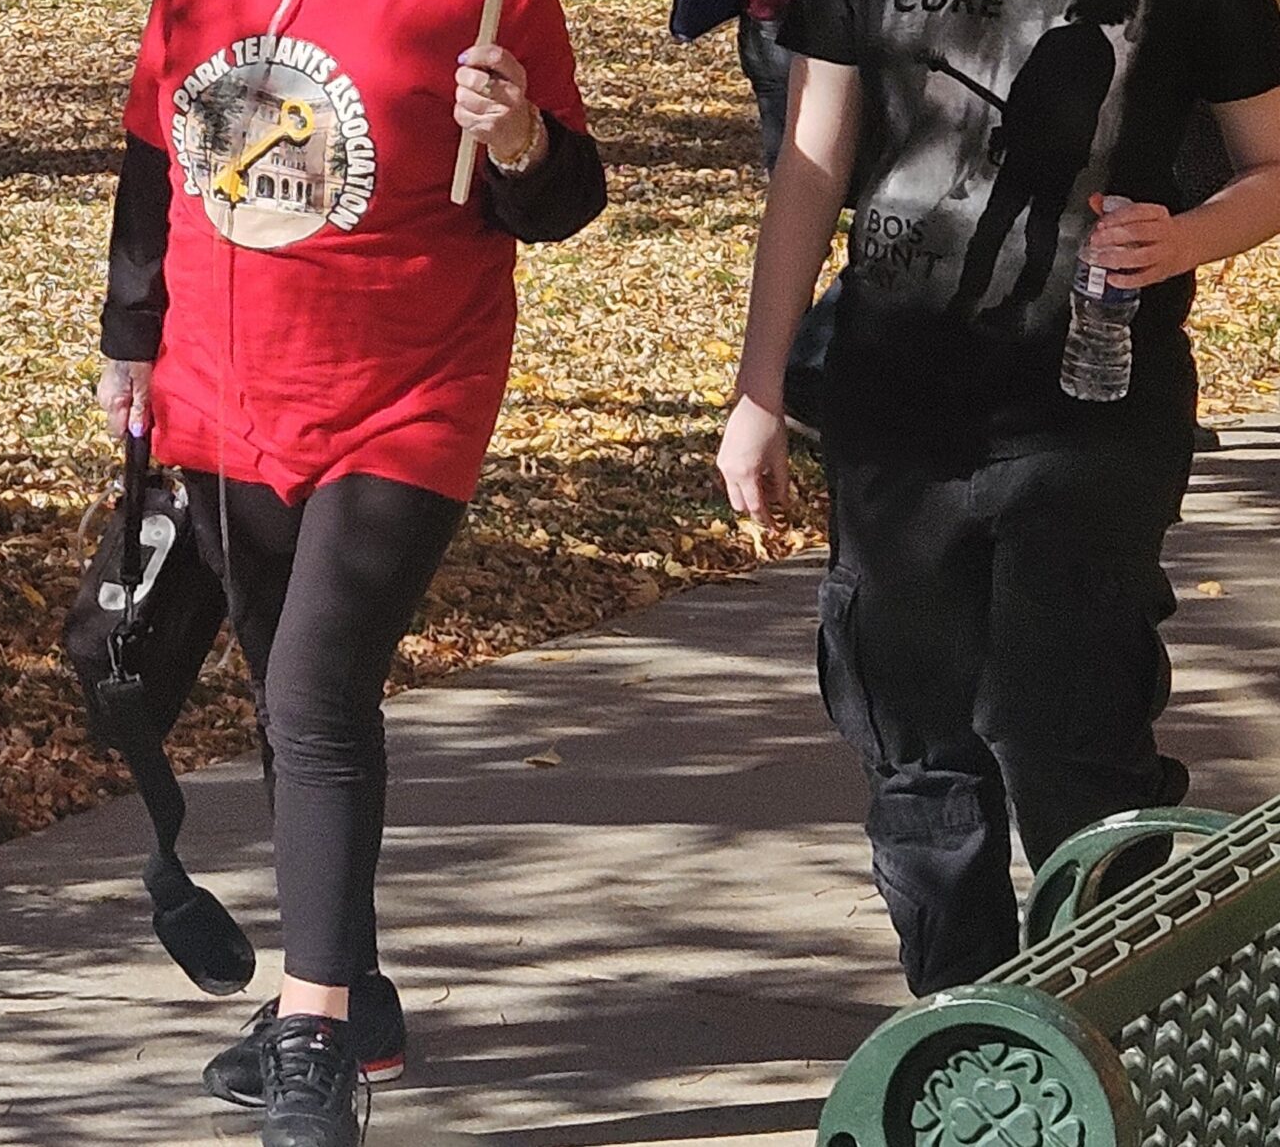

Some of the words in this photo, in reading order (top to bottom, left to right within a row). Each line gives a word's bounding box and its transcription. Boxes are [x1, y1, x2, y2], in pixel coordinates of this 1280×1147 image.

[173, 49, 232, 113] PARK
[231, 34, 338, 83] TENANTS
[323, 73, 377, 232] ASSOCIATION
[867, 208, 928, 244] BOS
